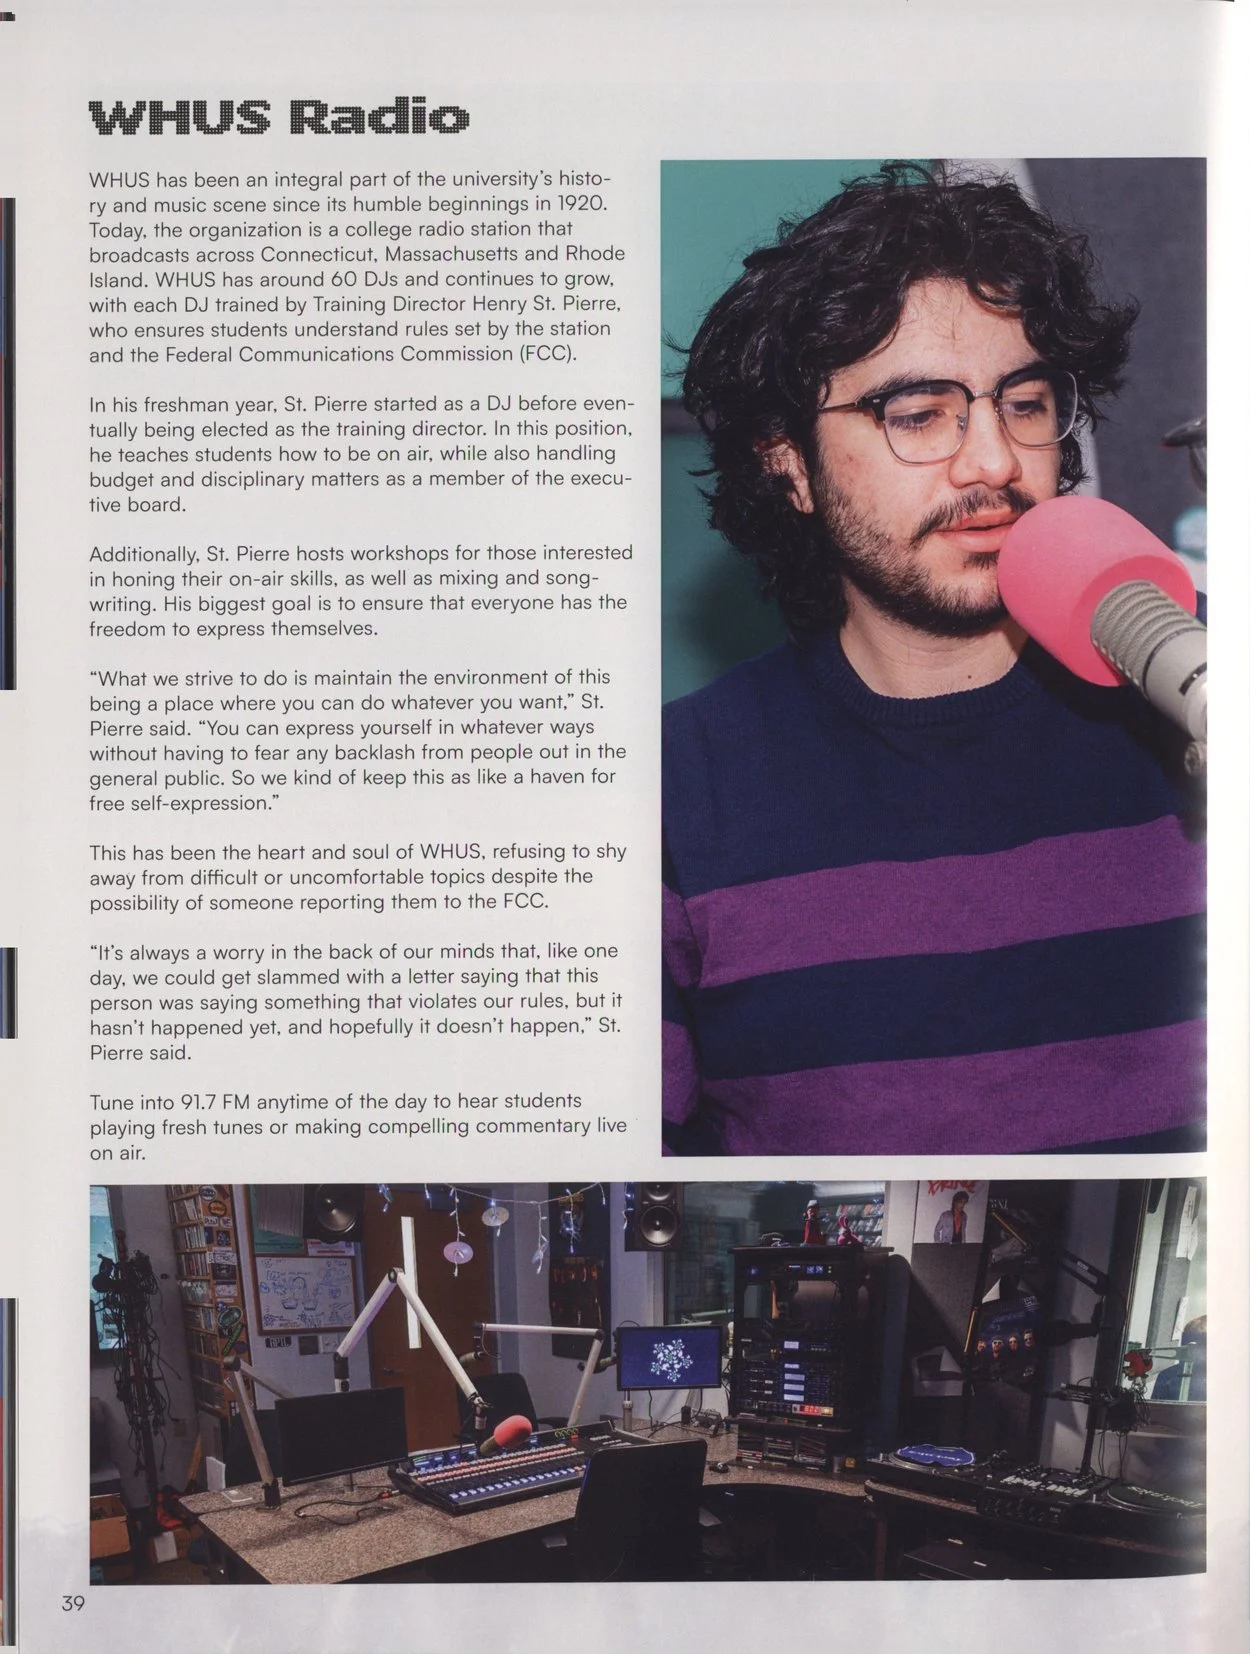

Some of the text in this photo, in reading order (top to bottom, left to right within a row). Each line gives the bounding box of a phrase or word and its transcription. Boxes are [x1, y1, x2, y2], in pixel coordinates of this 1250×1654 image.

[87, 95, 471, 137] WHUS Radio
[89, 193, 608, 218] ry and music scene since its humble beginnings in 1920.
[89, 244, 626, 265] broadcasts across Connecticut, Massachusetts and Rhode
[89, 343, 577, 365] and the Federal Communications Commission (FCC).
[88, 543, 633, 567] Additionally, St. Pierre hosts workshops for those interested
[88, 618, 379, 641] freedom to express themselves.
[88, 794, 125, 812] free
[89, 866, 594, 891] away from difficult or uncomfortable topics despite the
[89, 1091, 582, 1115] Tune into 91.7 FM anytime of the day to hear students
[90, 1115, 628, 1141] playing fresh tunes or making compelling commentary live
[61, 1594, 86, 1612] 39
